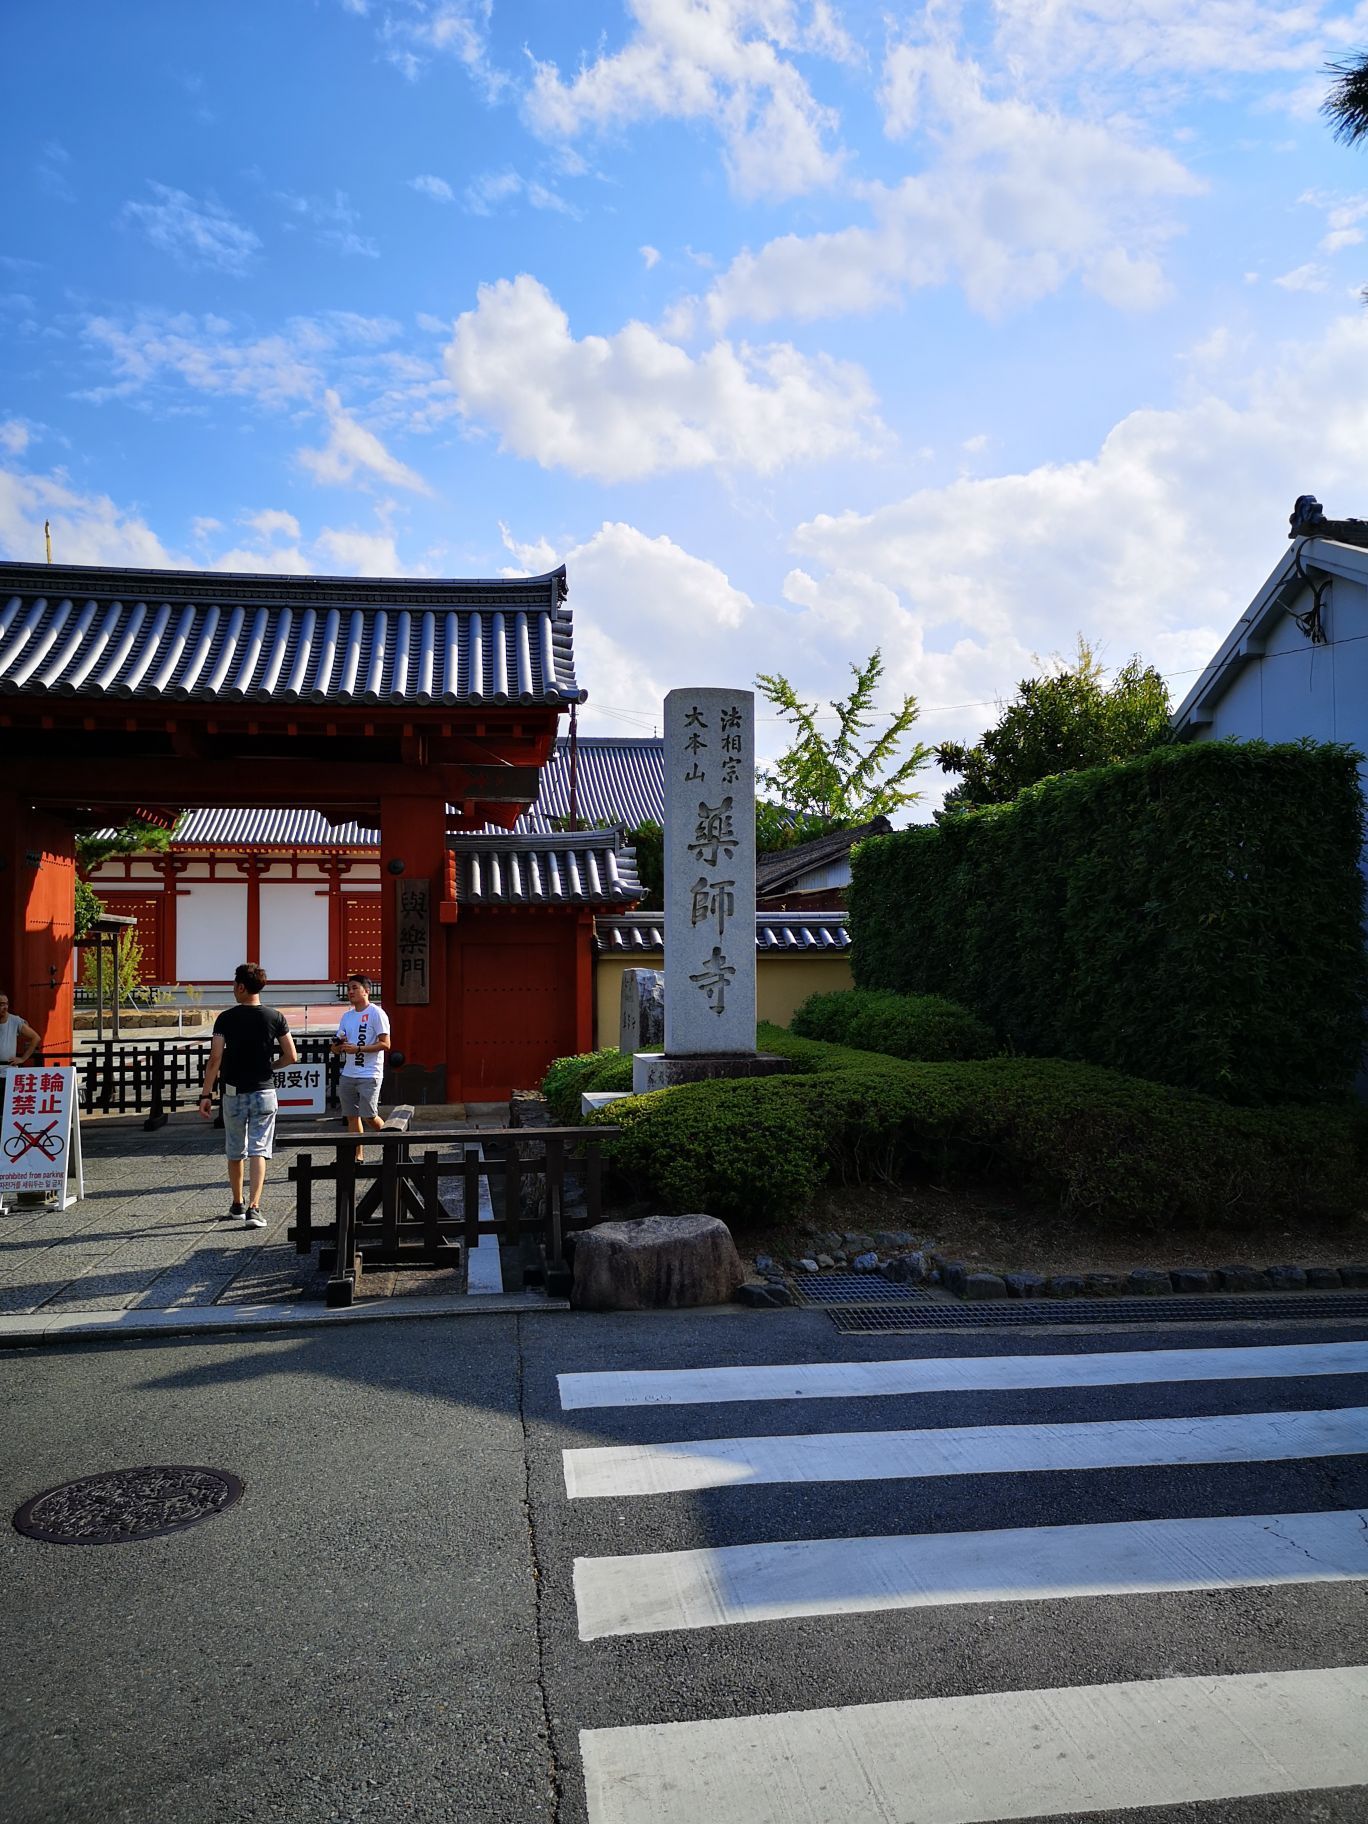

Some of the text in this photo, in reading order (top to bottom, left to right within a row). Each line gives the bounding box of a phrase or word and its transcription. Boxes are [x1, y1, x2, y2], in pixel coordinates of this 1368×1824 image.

[684, 706, 709, 783] 大本山
[720, 706, 742, 784] 法相宗
[12, 1095, 62, 1115] 禁止
[14, 1073, 64, 1093] 駐輪
